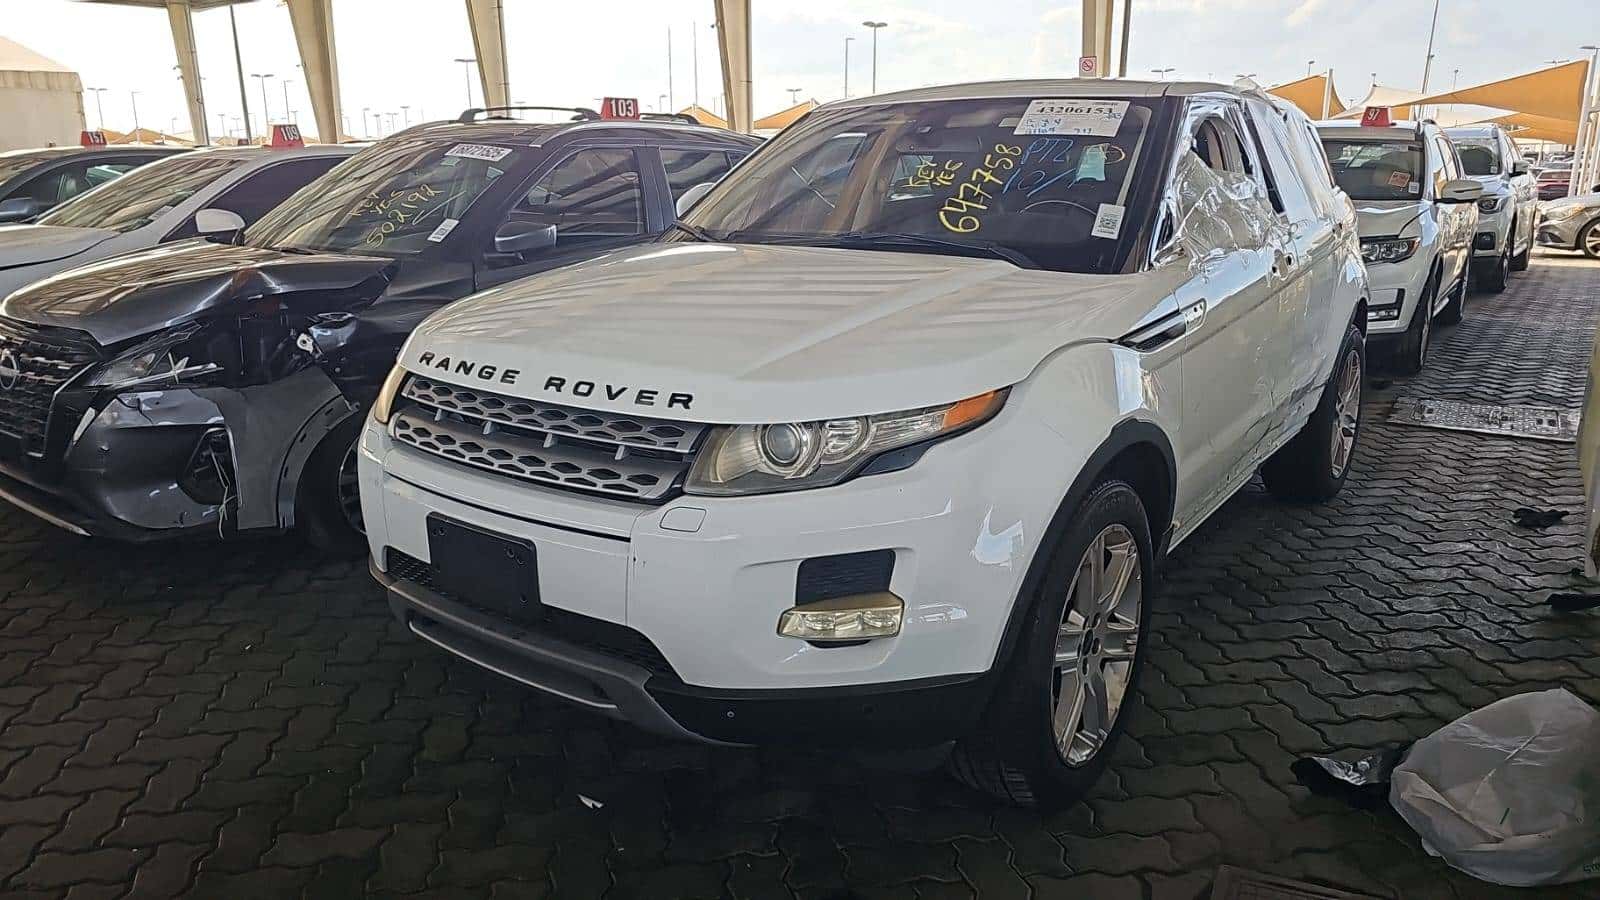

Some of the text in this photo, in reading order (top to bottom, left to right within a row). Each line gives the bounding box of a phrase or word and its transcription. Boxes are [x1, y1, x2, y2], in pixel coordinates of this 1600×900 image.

[611, 99, 635, 117] 103
[1036, 105, 1114, 115] 43206153
[1367, 108, 1380, 121] 97
[280, 126, 300, 141] 109
[939, 143, 1022, 233] 647758
[366, 183, 445, 249] 502192
[418, 350, 694, 410] RANGE ROVER
